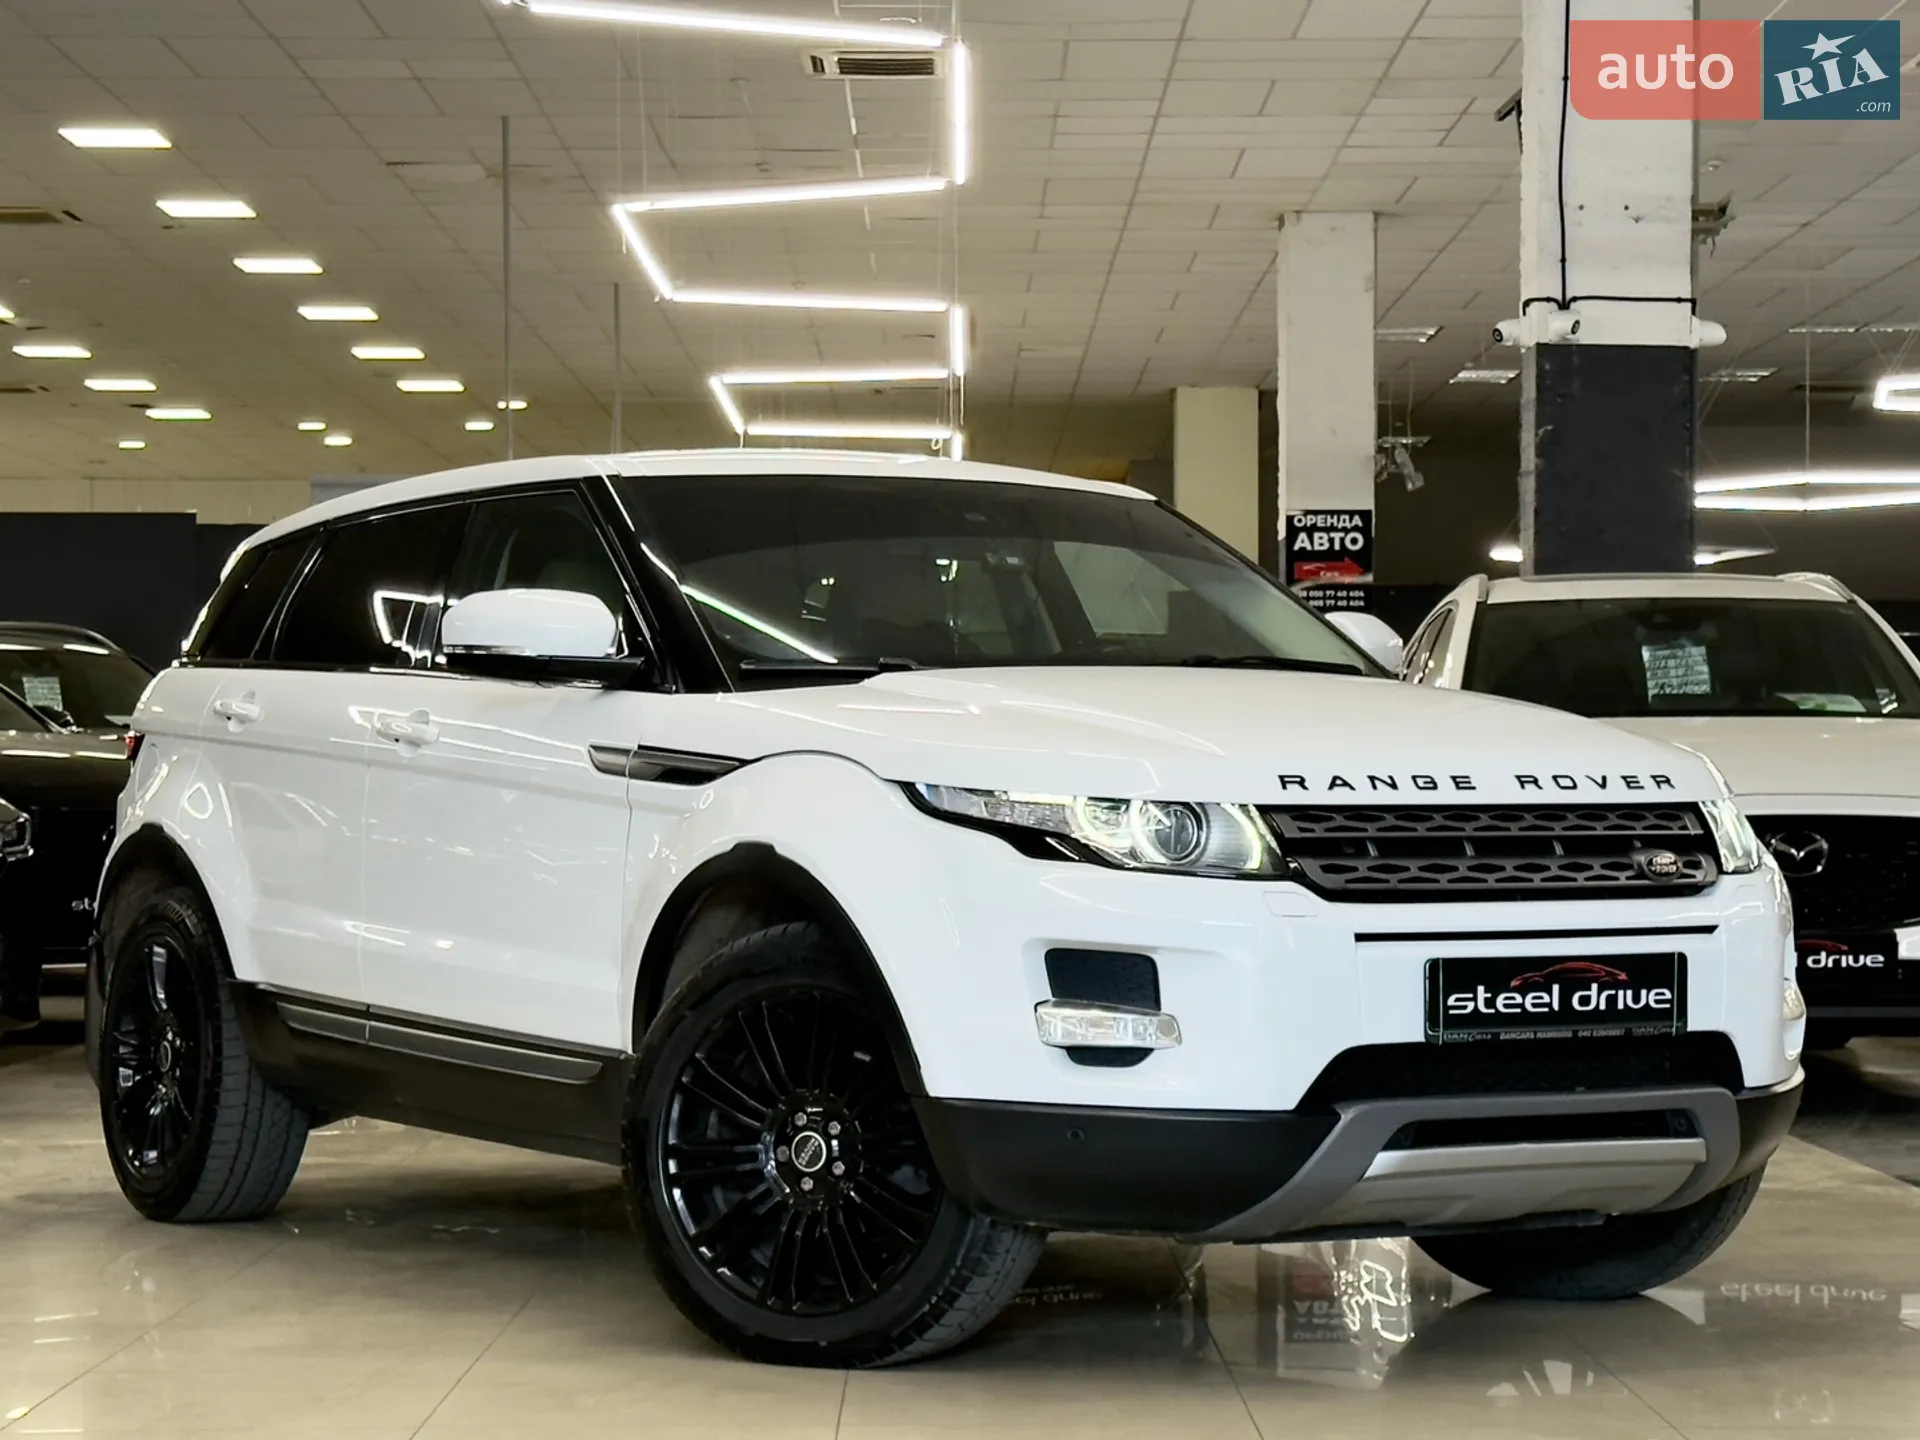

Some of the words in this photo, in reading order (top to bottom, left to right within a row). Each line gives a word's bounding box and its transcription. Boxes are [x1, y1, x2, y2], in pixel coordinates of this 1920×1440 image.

[1293, 514, 1363, 529] ОРЕНДА
[1292, 531, 1364, 551] АВТО
[1325, 590, 1336, 598] 77
[1325, 599, 1336, 607] 77
[1277, 774, 1477, 791] RANGE
[1514, 773, 1676, 790] ROVER
[1806, 951, 1885, 968] drive
[1447, 983, 1559, 1014] steel
[1571, 982, 1672, 1012] drive
